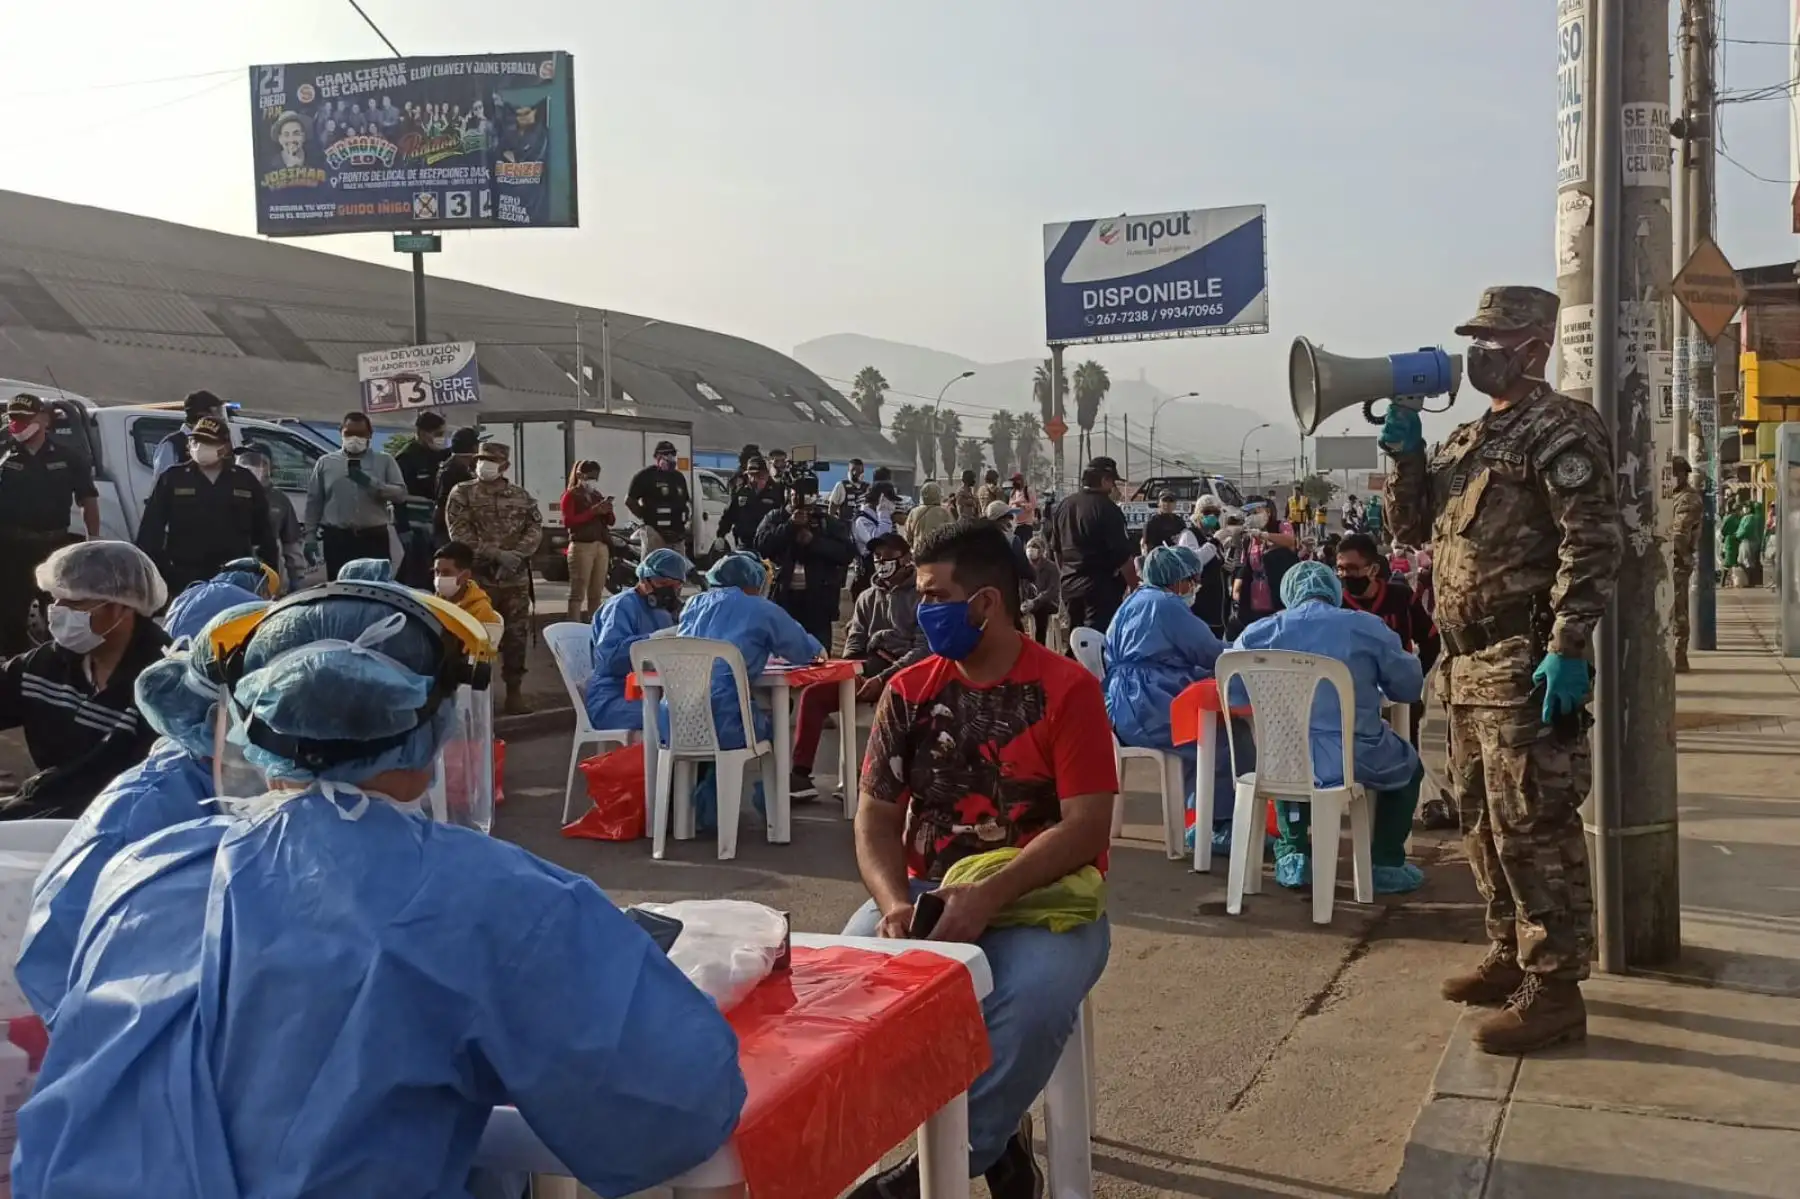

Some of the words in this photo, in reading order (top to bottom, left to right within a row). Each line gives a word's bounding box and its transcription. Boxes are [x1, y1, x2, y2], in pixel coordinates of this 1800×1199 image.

[316, 72, 353, 88] GRAN
[356, 62, 408, 81] CIERRE
[410, 64, 433, 81] ELOY
[473, 61, 500, 74] JAIME
[500, 60, 537, 76] PERALTA
[260, 66, 284, 95] 23
[260, 93, 286, 108] ENERO
[321, 86, 340, 98] DE
[1624, 108, 1645, 127] SE
[419, 167, 469, 179] RECEPCIONES
[337, 203, 375, 216] GUIDO
[451, 193, 468, 217] 3
[1125, 212, 1192, 247] input
[1083, 278, 1223, 310] DISPONIBLE
[1096, 311, 1149, 326] 267-7238
[1160, 304, 1224, 320] 993470965
[390, 343, 461, 360] DEVOLUCIÓN
[381, 360, 420, 371] APORTES
[431, 354, 456, 366] AFP
[435, 389, 478, 405] LUNA
